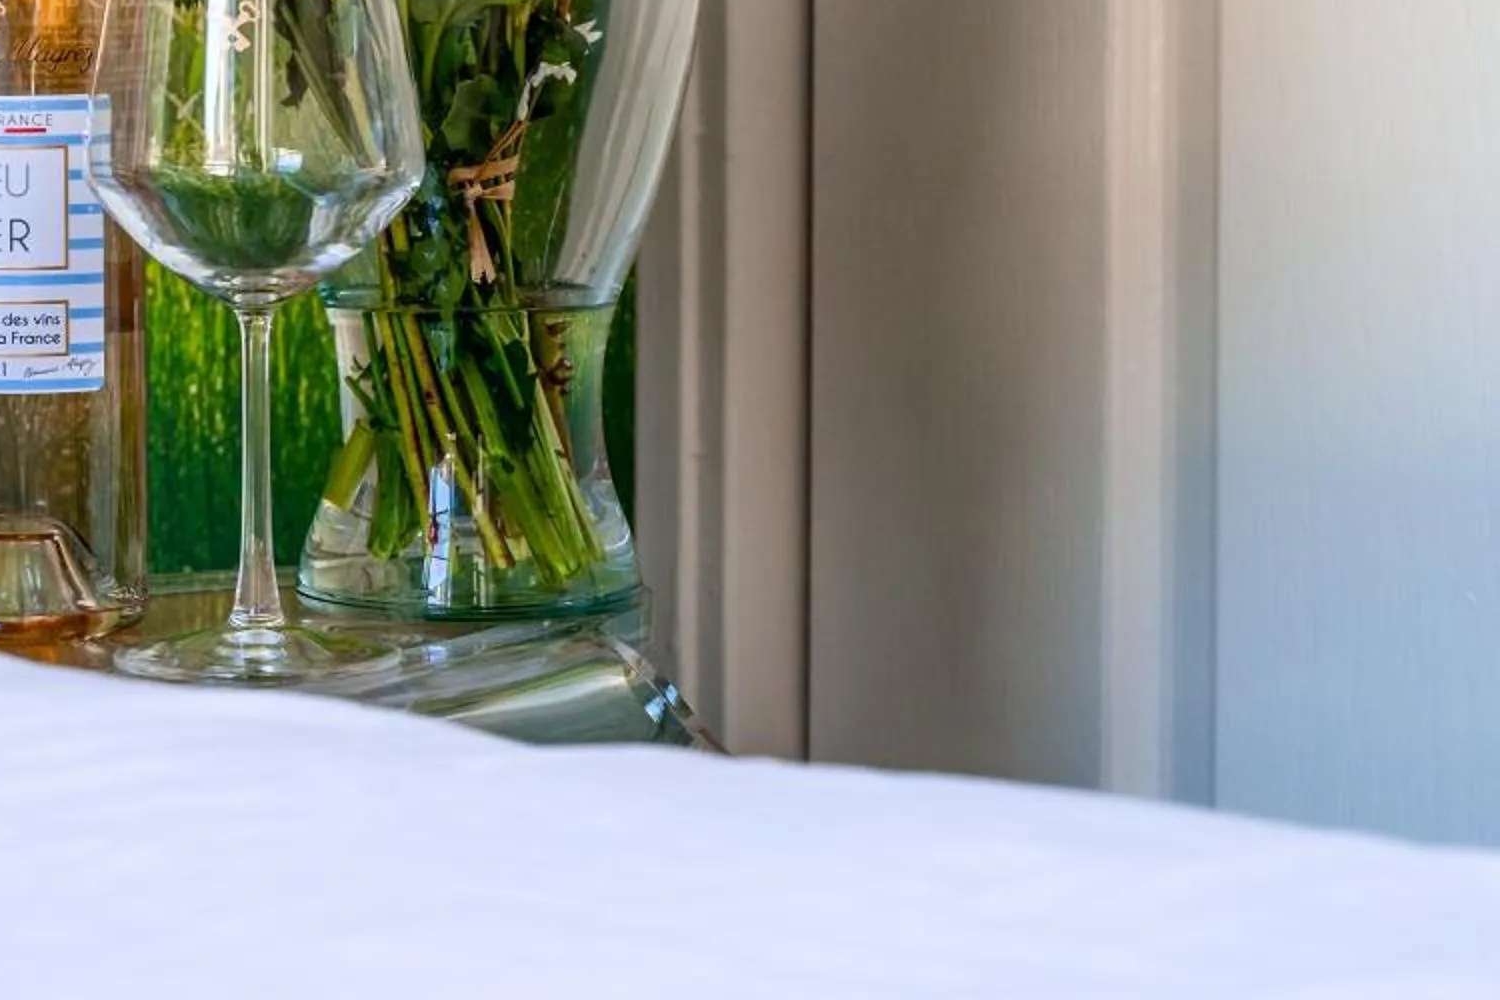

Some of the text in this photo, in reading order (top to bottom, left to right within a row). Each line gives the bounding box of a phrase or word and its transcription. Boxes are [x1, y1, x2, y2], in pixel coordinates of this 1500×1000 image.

[2, 311, 29, 327] des
[33, 312, 61, 326] vins
[11, 331, 61, 345] France
